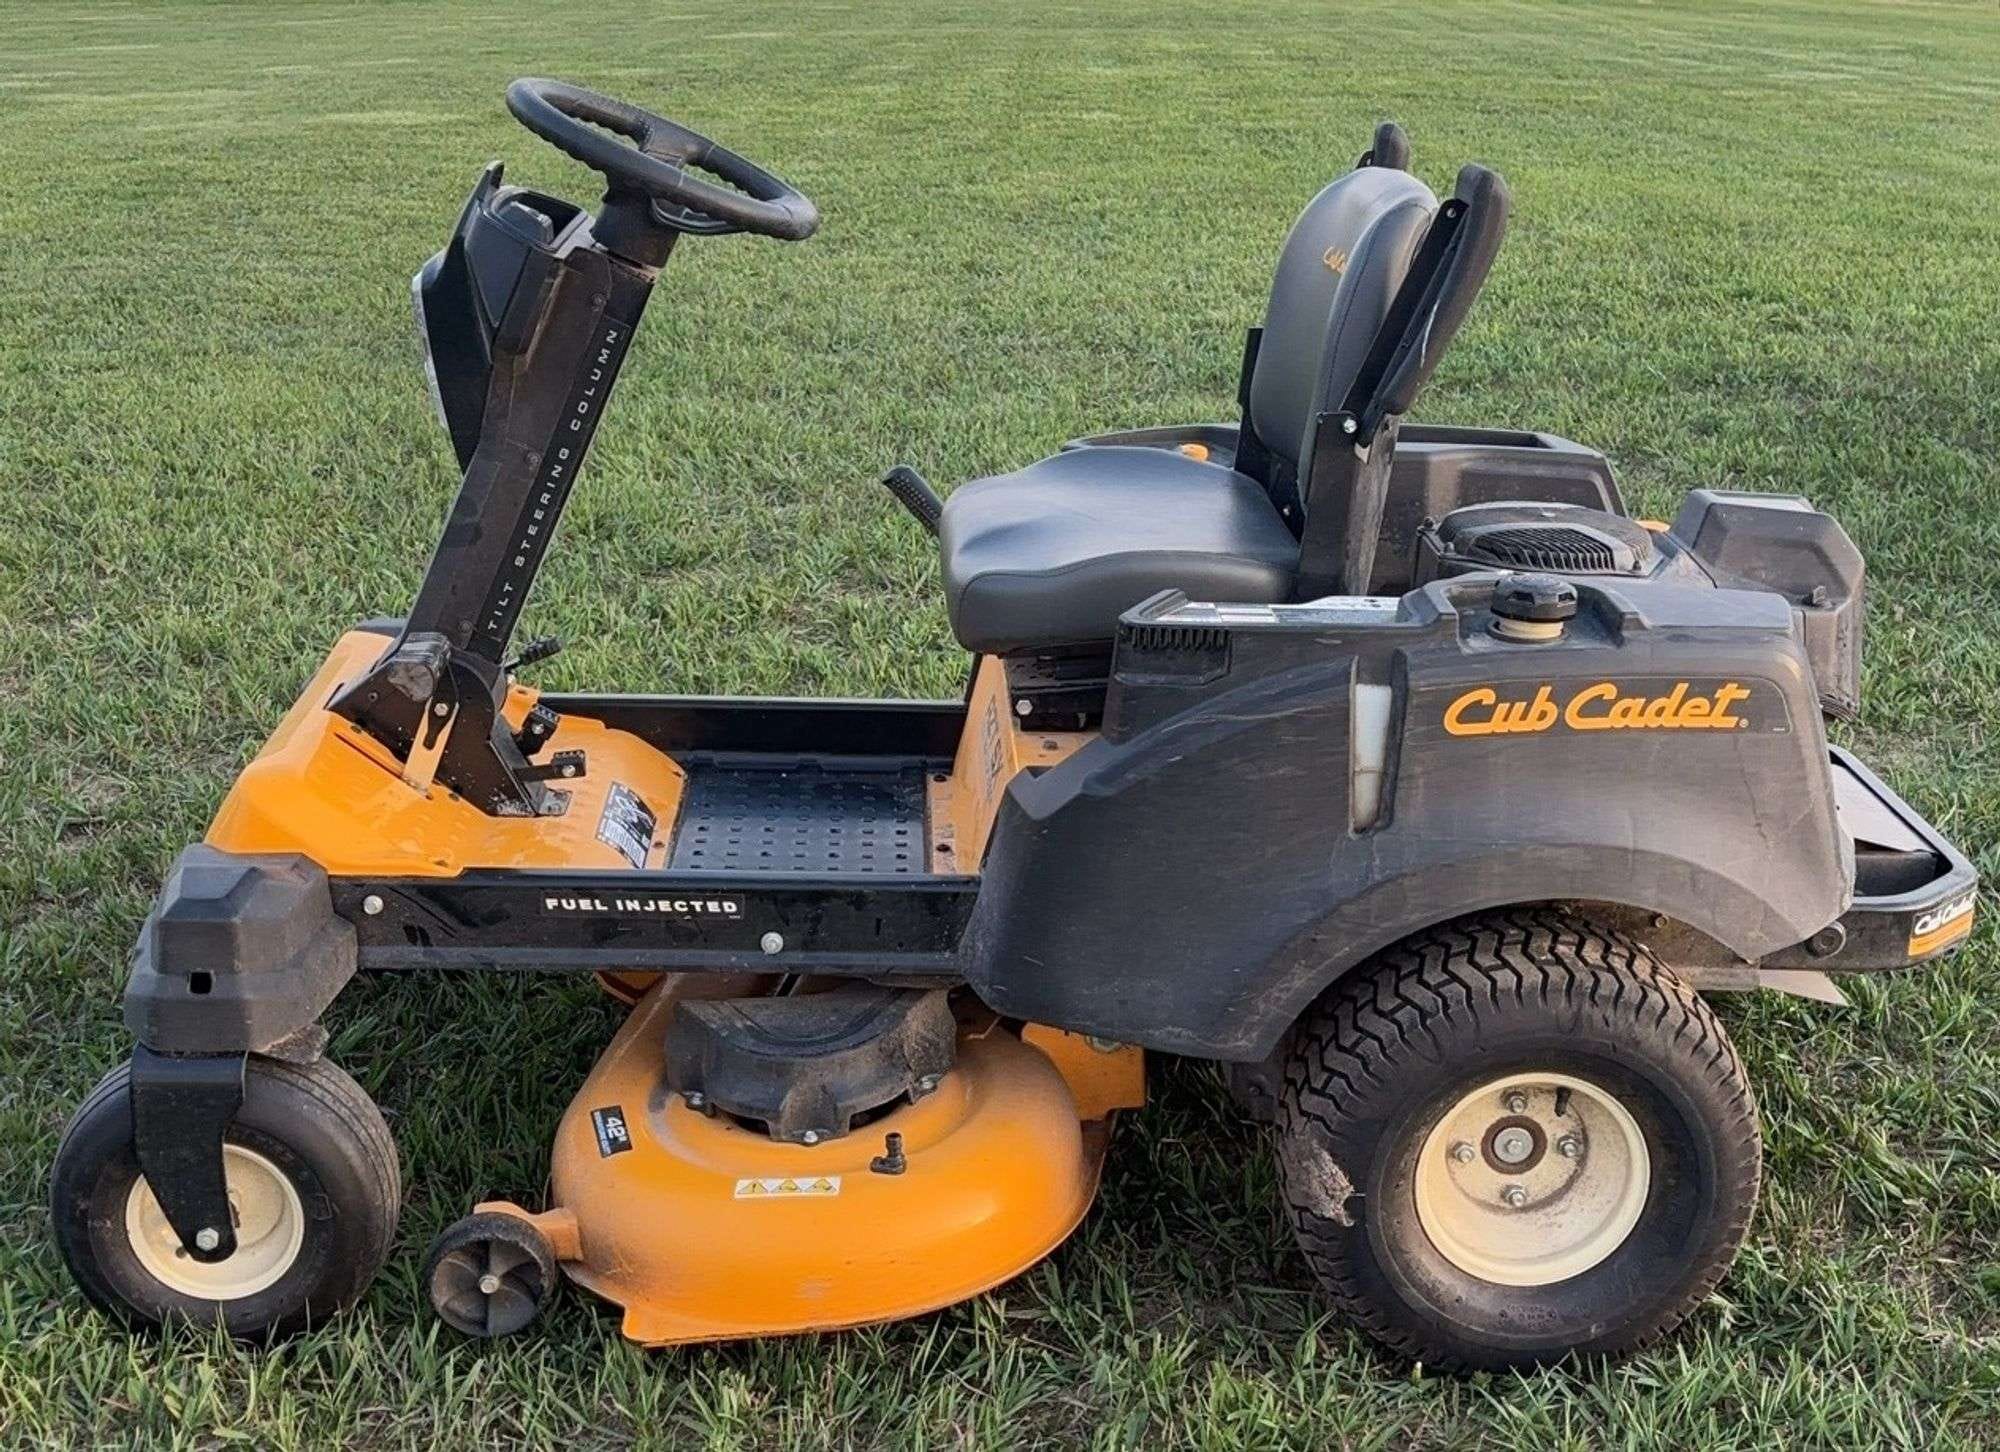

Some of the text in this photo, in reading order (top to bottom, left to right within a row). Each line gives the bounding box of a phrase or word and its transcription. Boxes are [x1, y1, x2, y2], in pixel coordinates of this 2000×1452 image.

[487, 328, 618, 631] TILT STEERING COLUMN
[1443, 682, 1751, 736] Cub Cadet
[545, 898, 738, 913] FUEL INJECTED
